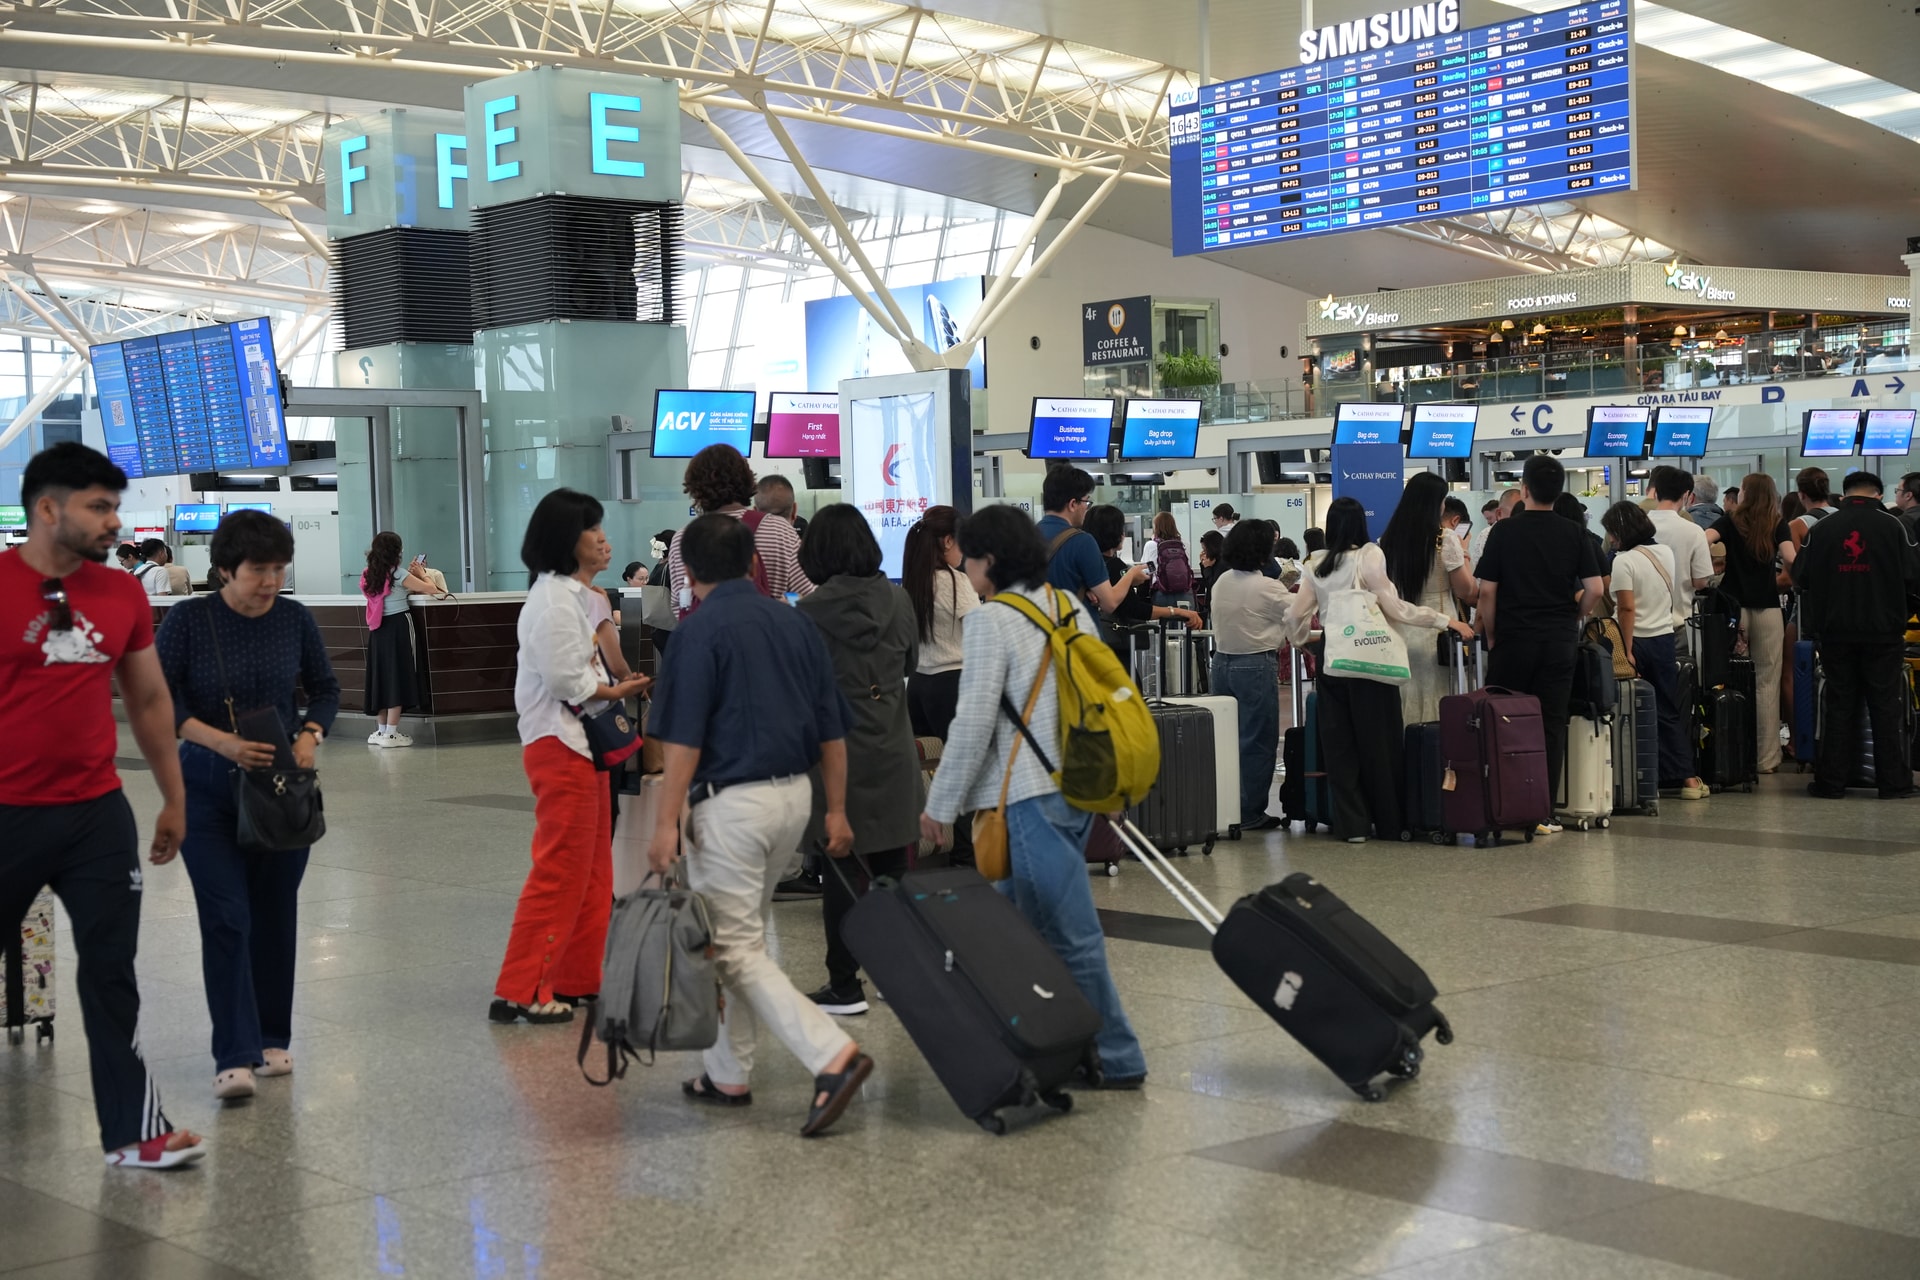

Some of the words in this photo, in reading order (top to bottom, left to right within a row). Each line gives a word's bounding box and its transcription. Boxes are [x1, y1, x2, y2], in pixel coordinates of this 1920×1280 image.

[1299, 0, 1458, 65] SAMSUNG
[1597, 22, 1623, 33] Check-in
[1598, 39, 1623, 49] Check-in
[1442, 57, 1466, 66] Boarding
[1442, 72, 1466, 81] Boarding
[1471, 83, 1487, 92] 18:40
[1598, 56, 1623, 66] Check-in
[1174, 91, 1195, 104] ACV
[1443, 88, 1466, 97] Check-in
[1443, 104, 1466, 113] Check-in
[1472, 115, 1487, 124] 19:00
[1569, 96, 1590, 106] B1-B12
[1172, 119, 1183, 133] 16
[1186, 117, 1199, 130] 43
[1443, 120, 1466, 128] Check-in
[1472, 131, 1487, 140] 19:00
[1569, 112, 1590, 122] B1-B12
[1569, 129, 1590, 139] B1-B12
[1599, 123, 1624, 134] Check-in
[484, 95, 523, 182] E
[589, 92, 645, 178] E
[1570, 146, 1590, 155] B1-B12
[1444, 152, 1467, 160] Check-in
[1570, 162, 1591, 172] B1-B12
[340, 135, 369, 215] F
[435, 133, 468, 209] F
[1473, 195, 1488, 203] 19:10
[1600, 173, 1625, 183] Check-in
[1305, 189, 1327, 199] Technical
[1306, 206, 1327, 214] Boarding
[1679, 271, 1711, 298] sky
[1706, 287, 1735, 301] Bistro
[1508, 297, 1534, 309] FOOD
[1542, 292, 1577, 305] DRINKS
[1887, 297, 1907, 308] FOOD
[1085, 307, 1097, 321] 4F
[1335, 302, 1370, 326] sky
[1365, 312, 1399, 325] Bistro
[1097, 337, 1129, 350] COFFEE
[1132, 336, 1138, 346] &
[1091, 346, 1145, 361] RESTAURANT
[1678, 390, 1698, 402] TÀU
[1701, 390, 1721, 401] BAY
[658, 411, 706, 431] ACV
[1532, 404, 1553, 434] C
[807, 422, 823, 431] First
[1059, 425, 1085, 433] Business
[802, 433, 815, 441] Hạng
[815, 432, 826, 440] nhất
[1148, 430, 1159, 438] Bag
[1160, 430, 1173, 438] drop
[1357, 431, 1367, 440] Bag
[1368, 431, 1379, 440] drop
[1432, 432, 1454, 440] Economy
[1510, 428, 1526, 436] 45m
[1607, 432, 1628, 440] Economy
[1672, 432, 1691, 440] Economy
[1351, 472, 1374, 480] CATHAY
[1375, 472, 1397, 480] PACIFIC
[1193, 500, 1210, 509] E-04
[1286, 498, 1303, 507] E-05
[177, 512, 198, 521] ACV
[1354, 635, 1392, 647] EVOLUTION
